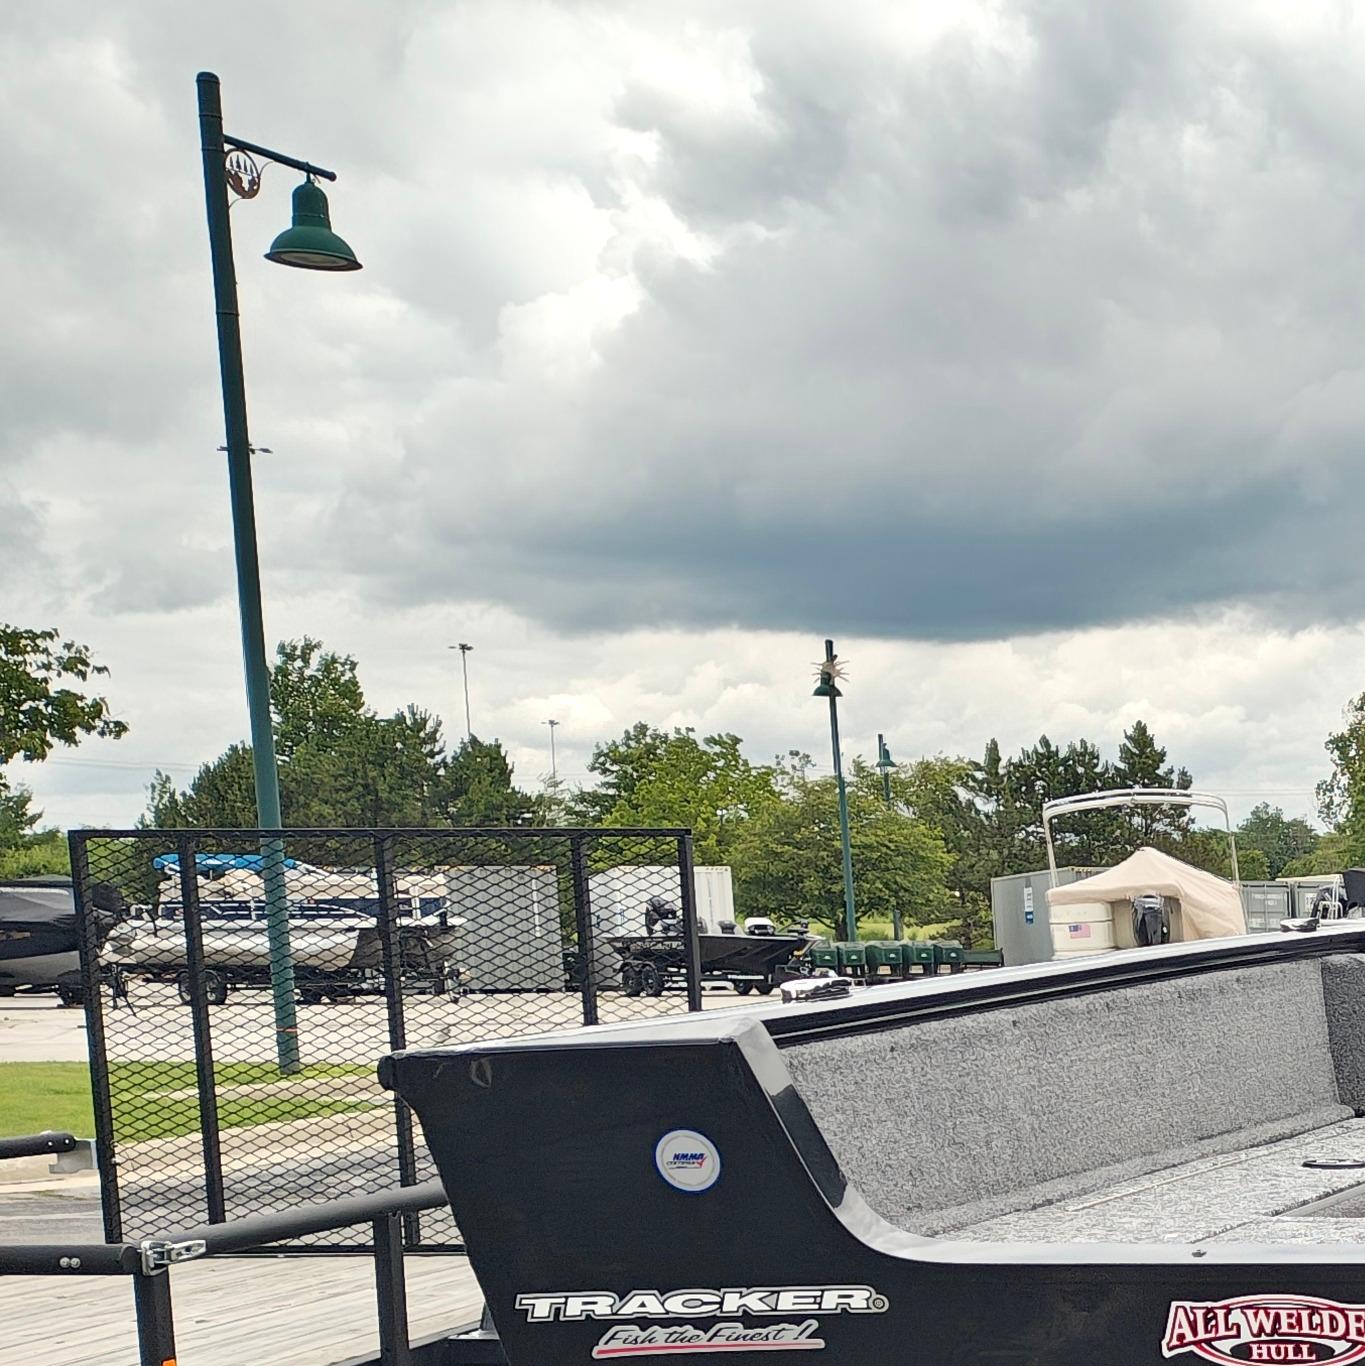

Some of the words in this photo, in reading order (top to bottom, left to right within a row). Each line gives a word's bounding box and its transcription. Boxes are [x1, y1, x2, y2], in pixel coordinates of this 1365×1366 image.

[519, 1289, 871, 1319] TRACKER
[604, 1328, 658, 1345] Fish
[664, 1327, 703, 1344] the
[1168, 1306, 1238, 1347] ALL
[1250, 1343, 1316, 1361] HULL
